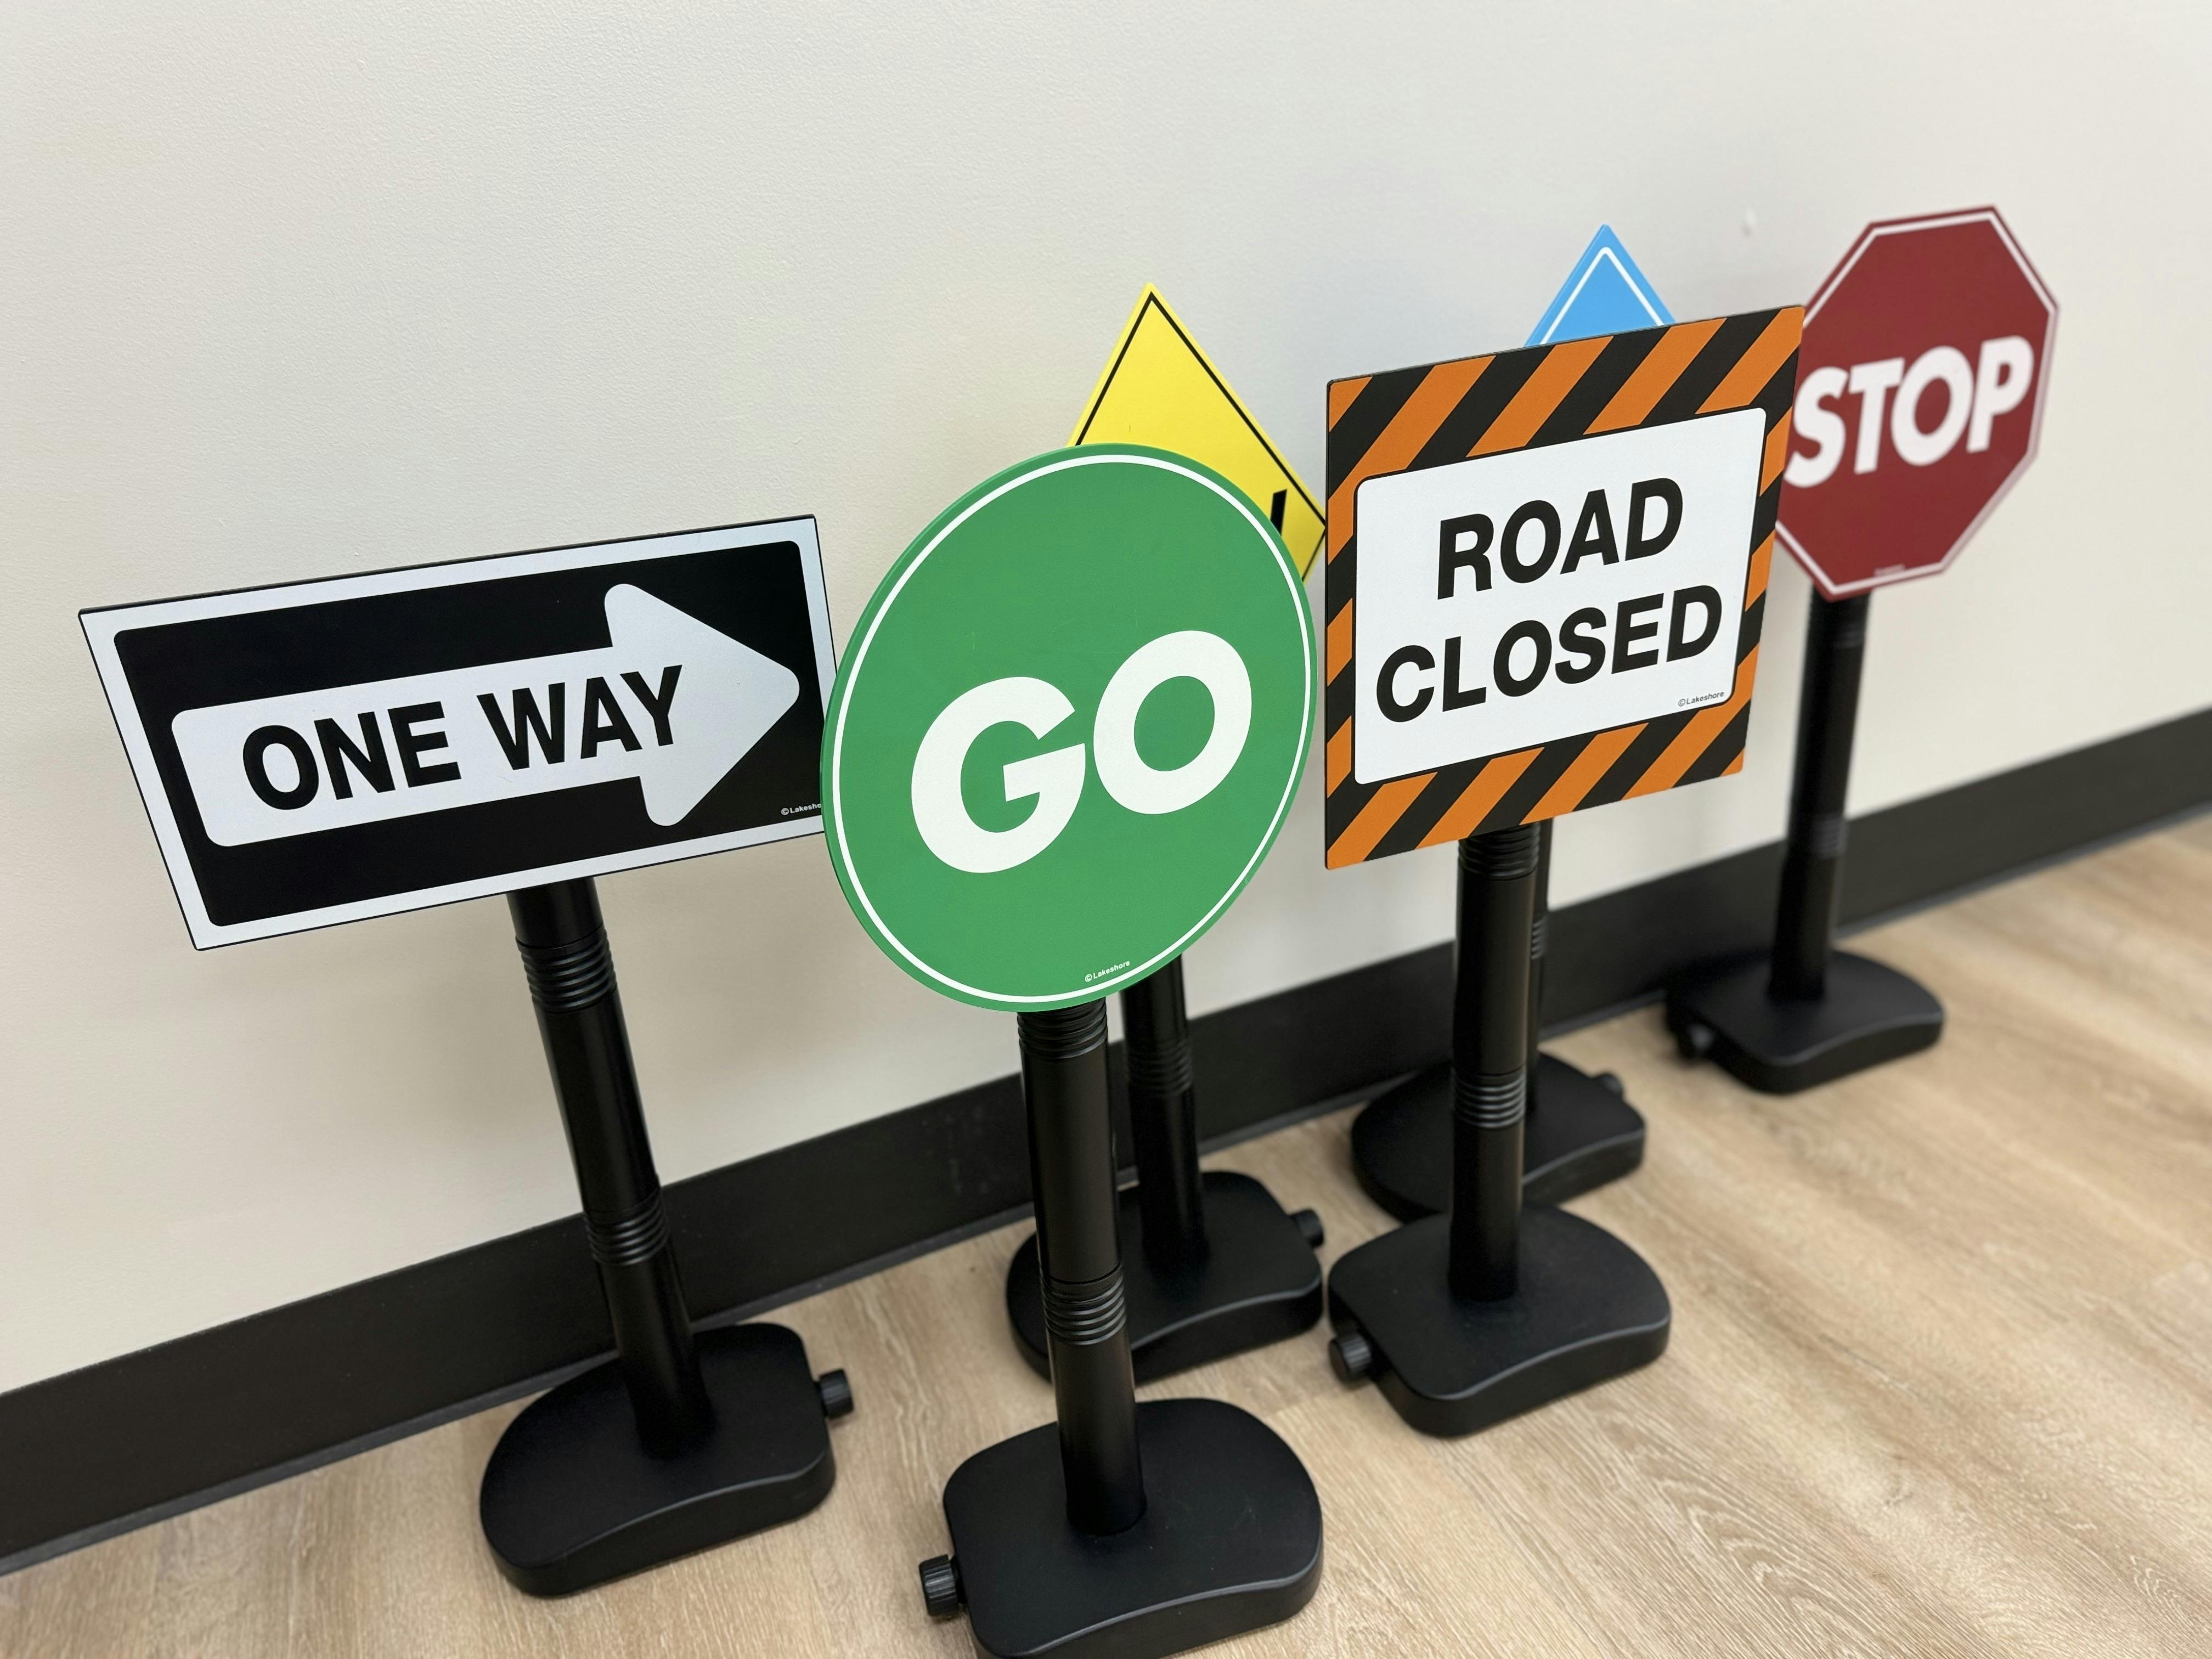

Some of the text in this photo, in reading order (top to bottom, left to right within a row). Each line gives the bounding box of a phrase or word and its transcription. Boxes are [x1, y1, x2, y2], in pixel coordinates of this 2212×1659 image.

[1783, 335, 2035, 488] STOP
[1437, 477, 1684, 600] ROAD
[1375, 585, 1723, 723] CLOSED
[242, 664, 682, 811] ONE WAY
[911, 629, 1252, 873] GO
[781, 803, 822, 816] ©Lakesho
